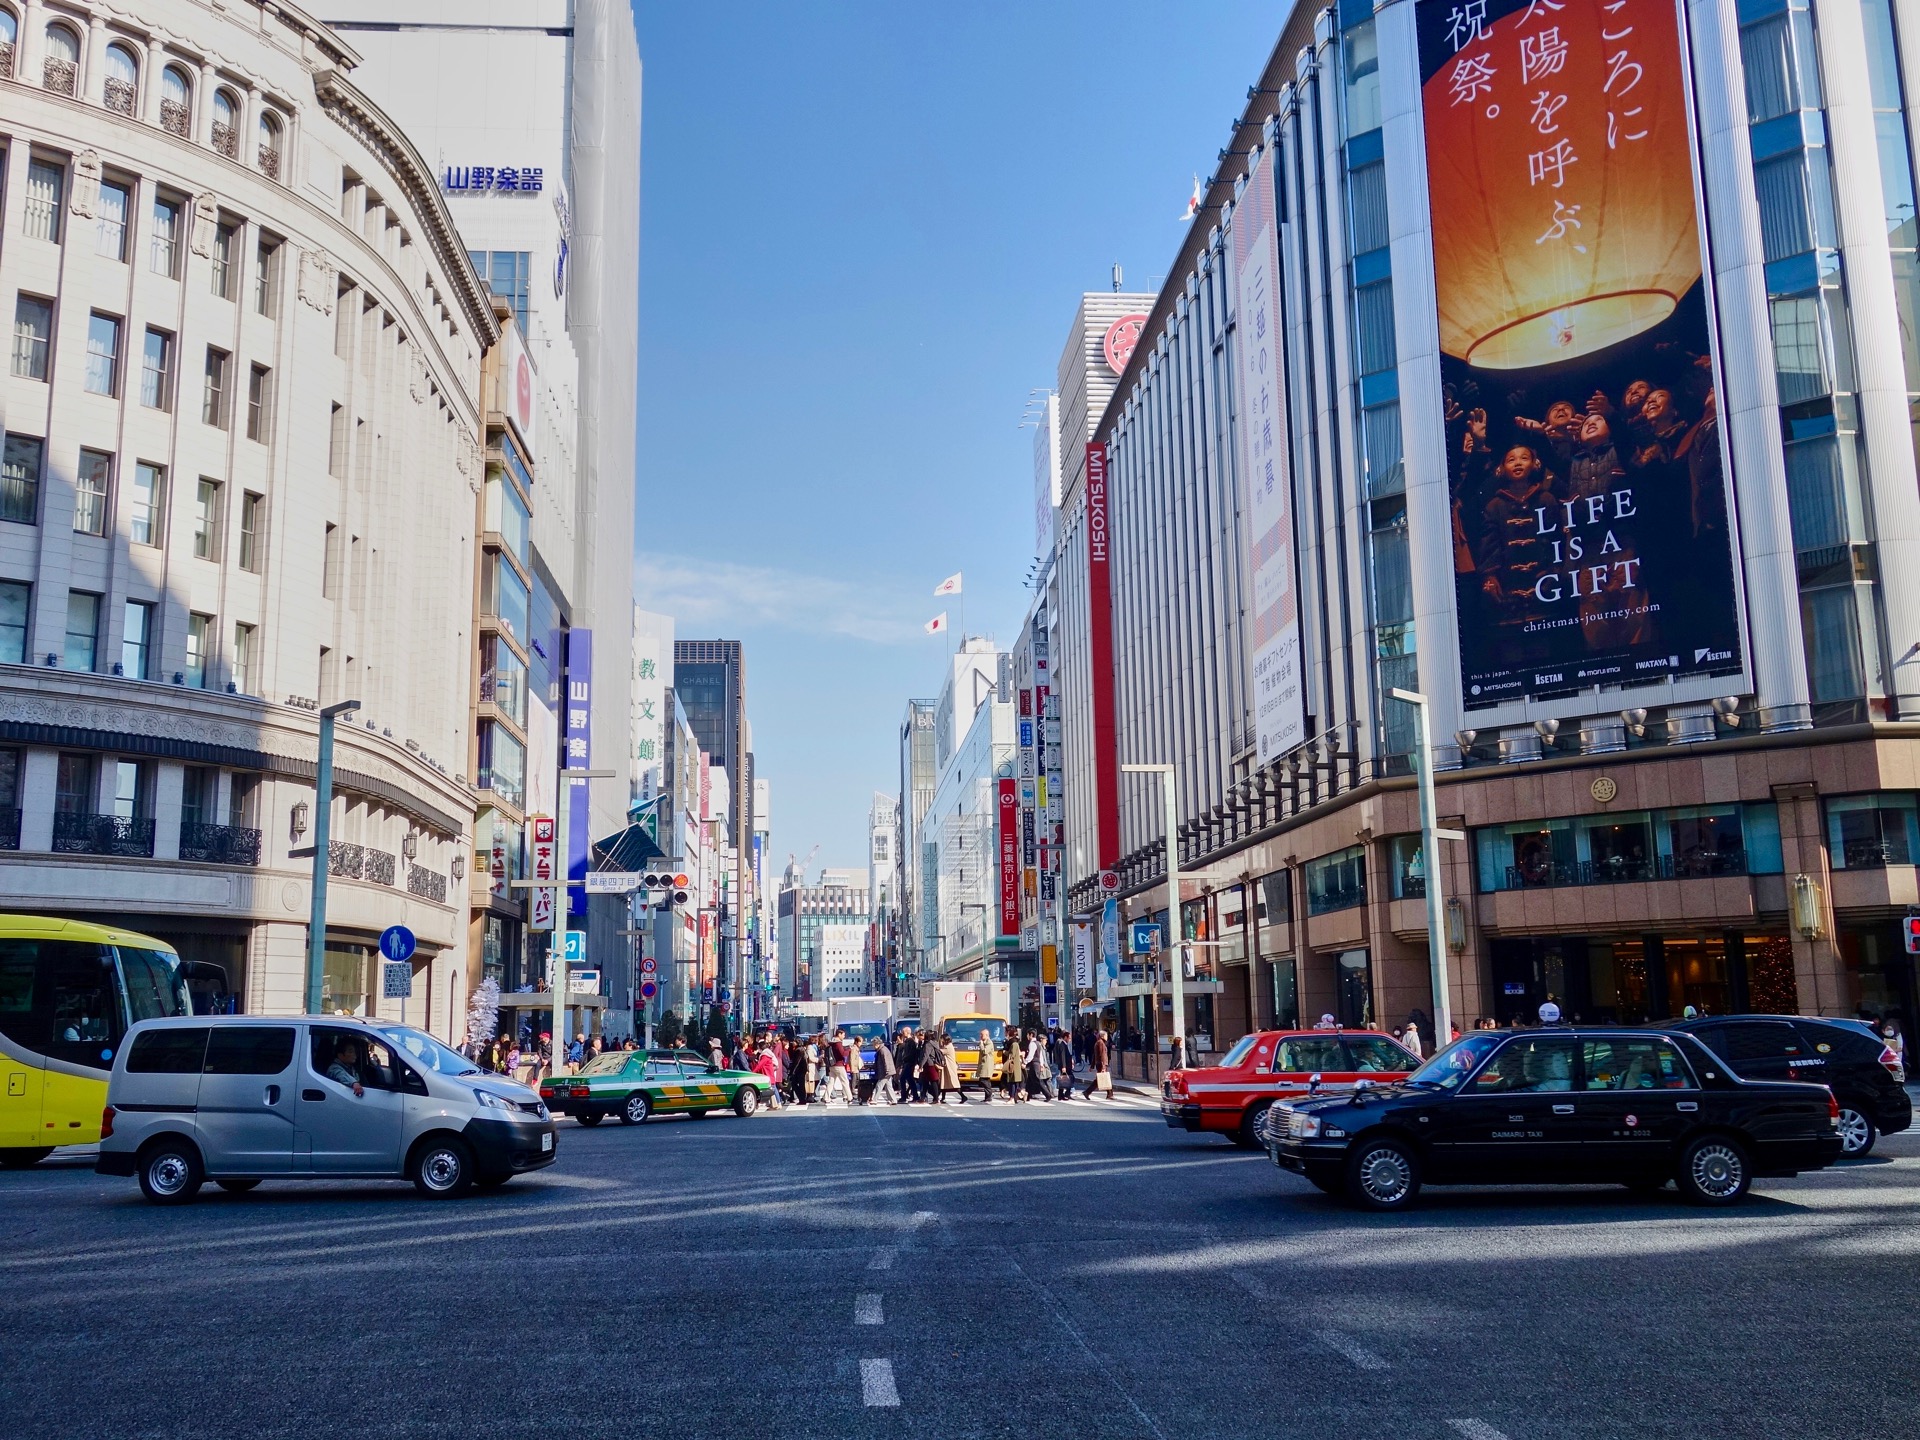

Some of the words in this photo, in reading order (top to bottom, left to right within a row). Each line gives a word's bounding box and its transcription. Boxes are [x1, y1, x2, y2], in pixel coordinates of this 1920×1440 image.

[1602, 0, 1649, 150] ころに
[446, 166, 544, 192] 山野楽器
[1254, 265, 1275, 496] 三越のお歳暮
[1089, 450, 1106, 562] MITSUKOSHI
[1535, 489, 1637, 535] LIFE
[1551, 536, 1583, 564] IS
[1600, 530, 1622, 555] A
[1535, 557, 1640, 602] GIFT
[1523, 602, 1661, 633] christmas-journey.com
[1492, 670, 1512, 679] japan.
[1635, 659, 1668, 670] IWATAYA
[1483, 681, 1522, 691] MITSUKOSHI
[637, 658, 656, 761] 教文館
[569, 681, 588, 786] 山野楽器
[1270, 721, 1298, 747] MITSUKOSHI
[590, 878, 635, 886] 銀座四丁目
[1004, 833, 1016, 921] 三菱東京UFJ銀行
[825, 930, 860, 940] LIXIL
[1077, 944, 1086, 986] MOTOKI
